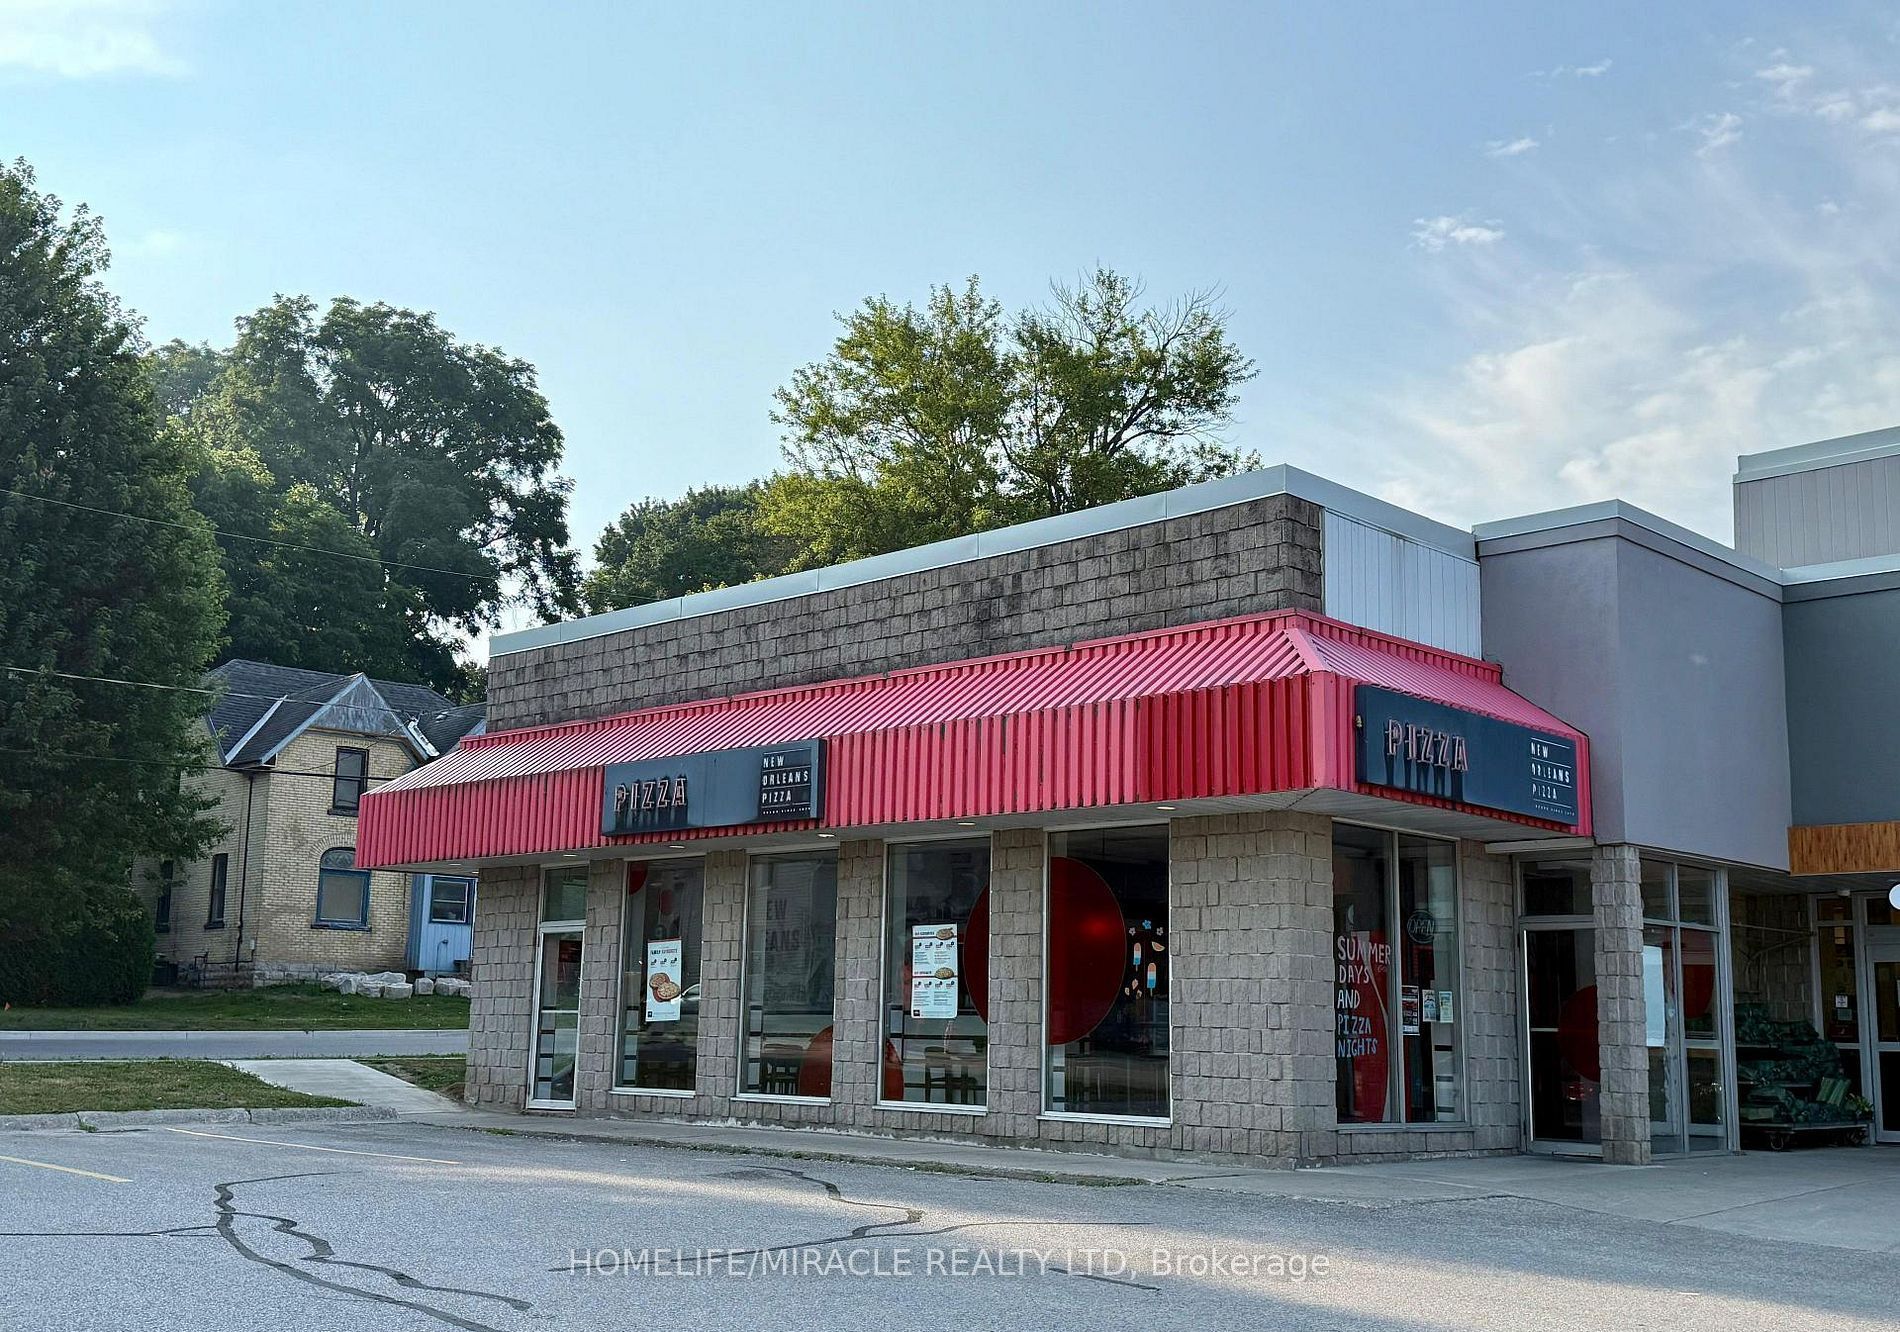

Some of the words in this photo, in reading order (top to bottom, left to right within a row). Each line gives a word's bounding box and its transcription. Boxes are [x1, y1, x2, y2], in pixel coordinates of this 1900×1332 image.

[1385, 719, 1468, 772] PIZZA
[1531, 742, 1549, 759] NEW
[763, 754, 785, 768] NEW
[762, 770, 809, 786] ORLEANS
[1531, 763, 1570, 783] ORLEANS
[614, 778, 688, 812] PIZZA
[762, 789, 792, 804] PIZZA
[1532, 783, 1558, 801] PIZZA
[767, 898, 788, 921] EW
[1409, 918, 1435, 936] OPEN
[1337, 935, 1391, 965] SUMMER
[1339, 964, 1370, 984] DAYS
[1337, 989, 1361, 1010] AND
[1338, 1014, 1372, 1036] PIZZA
[1338, 1038, 1378, 1058] NIGHTS
